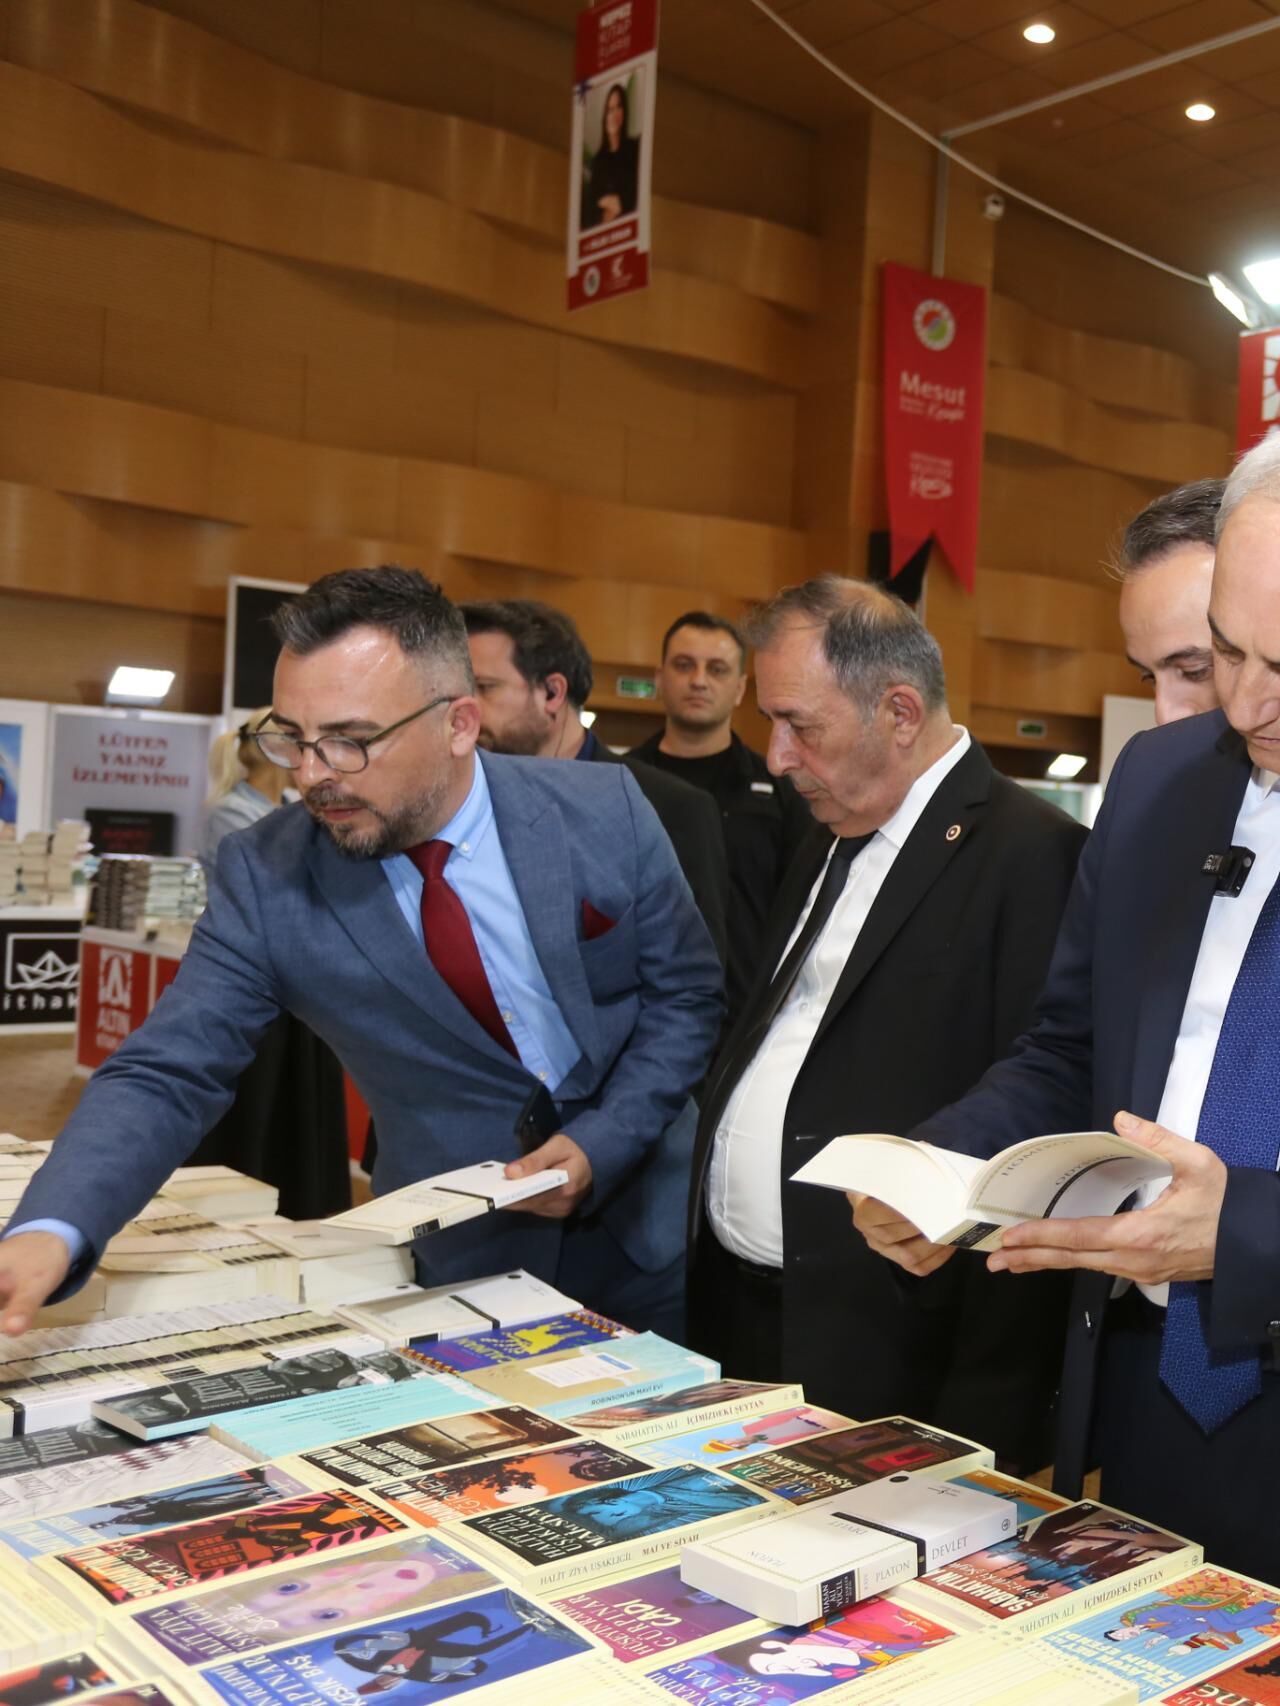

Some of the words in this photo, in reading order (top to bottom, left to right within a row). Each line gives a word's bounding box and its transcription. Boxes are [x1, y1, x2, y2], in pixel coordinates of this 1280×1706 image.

[901, 371, 965, 406] Mesut
[98, 732, 168, 750] LÜTFEN
[100, 752, 167, 768] YALNIZ
[615, 1424, 664, 1442] SABAHATTİN
[665, 1418, 679, 1430] ALİ
[686, 1408, 733, 1426] İÇİMİZDEKİ
[734, 1400, 765, 1415] ŞEYTAN
[757, 1451, 818, 1473] MEMNU
[407, 1475, 492, 1514] EĞİRMEN
[810, 1471, 860, 1489] AŞK-I
[472, 1517, 520, 1534] ZİYA
[493, 1512, 586, 1551] UŞAKLIGİL
[505, 1532, 567, 1558] HALİT
[540, 1570, 565, 1585] HALİT
[568, 1565, 588, 1577] ZİYA
[590, 1552, 632, 1571] UŞAKLIGİL
[642, 1543, 659, 1556] MAİ
[661, 1541, 671, 1551] VE
[674, 1533, 699, 1548] SİYAH
[875, 1560, 910, 1582] PLATON
[931, 1536, 968, 1561] DEVLET
[142, 1559, 200, 1587] SIRÇA
[929, 1571, 1035, 1612] SABAHATTİN
[1062, 1604, 1075, 1618] ALİ
[1083, 1585, 1131, 1610] İÇİMİZDEKİ
[1133, 1570, 1164, 1593] ŞEYTAN
[145, 1608, 197, 1635] ZİYA
[566, 1594, 681, 1649] GÜRPINAR
[612, 1598, 684, 1628] CADI
[587, 1623, 655, 1655] HÜSEYİN
[281, 1653, 326, 1678] BAŞ
